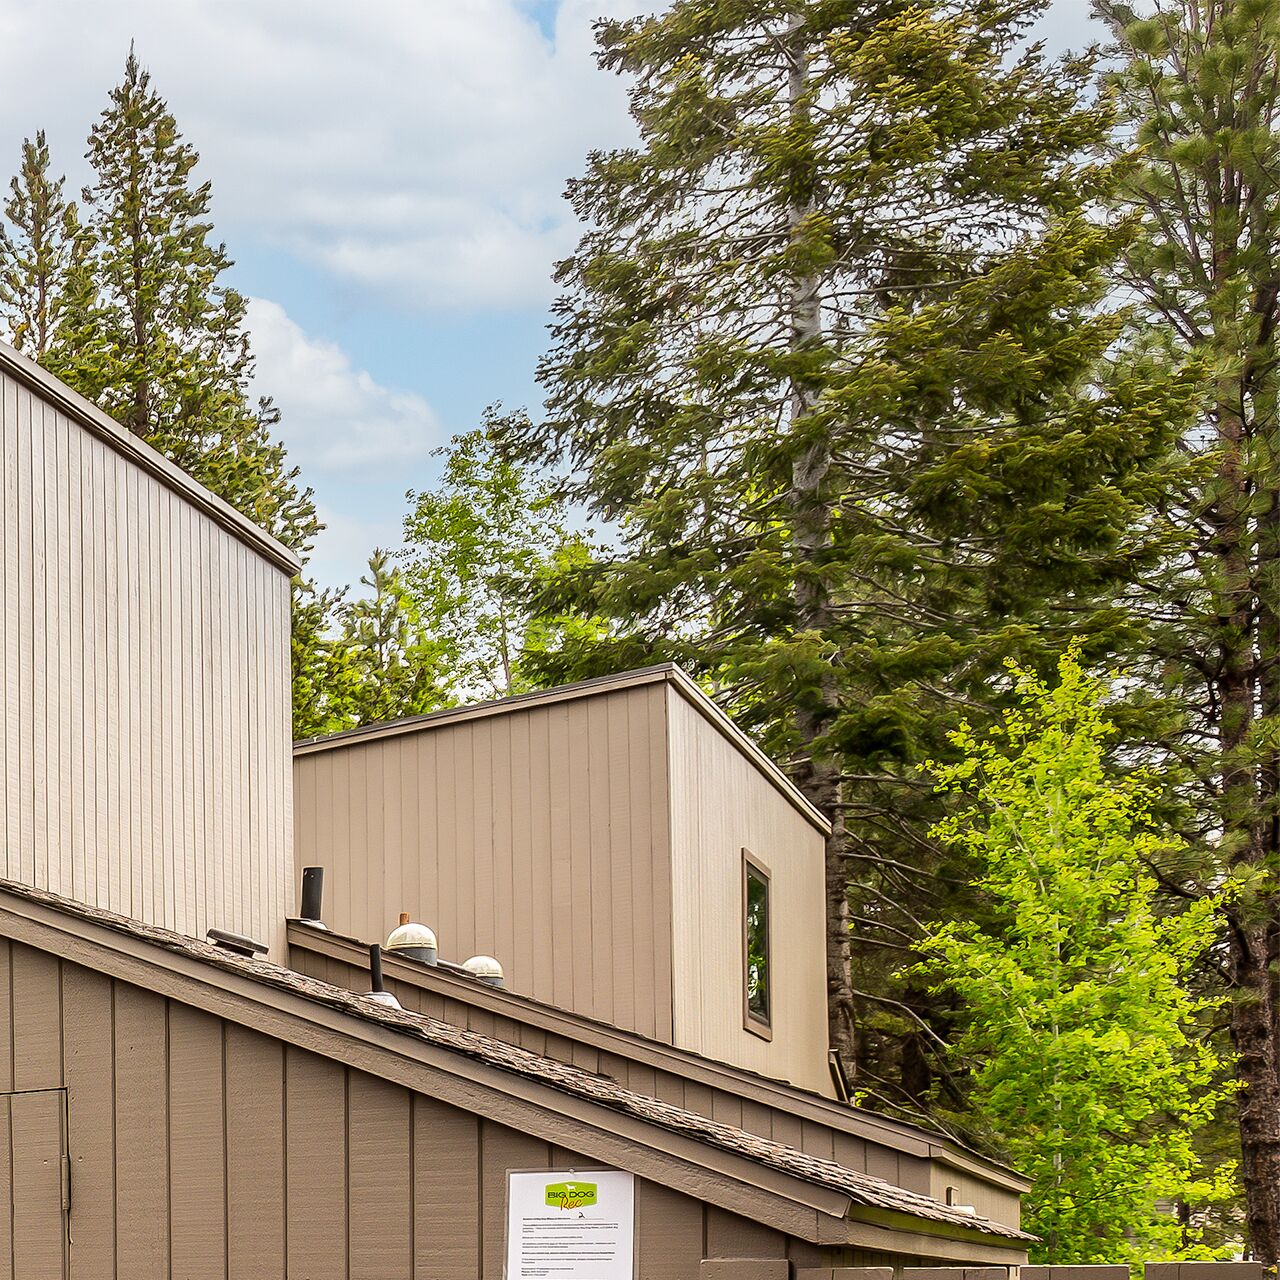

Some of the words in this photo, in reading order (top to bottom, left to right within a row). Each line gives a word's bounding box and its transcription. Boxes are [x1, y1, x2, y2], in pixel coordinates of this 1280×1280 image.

[547, 1191, 567, 1199] BIG
[569, 1190, 594, 1198] DOG
[560, 1195, 583, 1211] Rec
